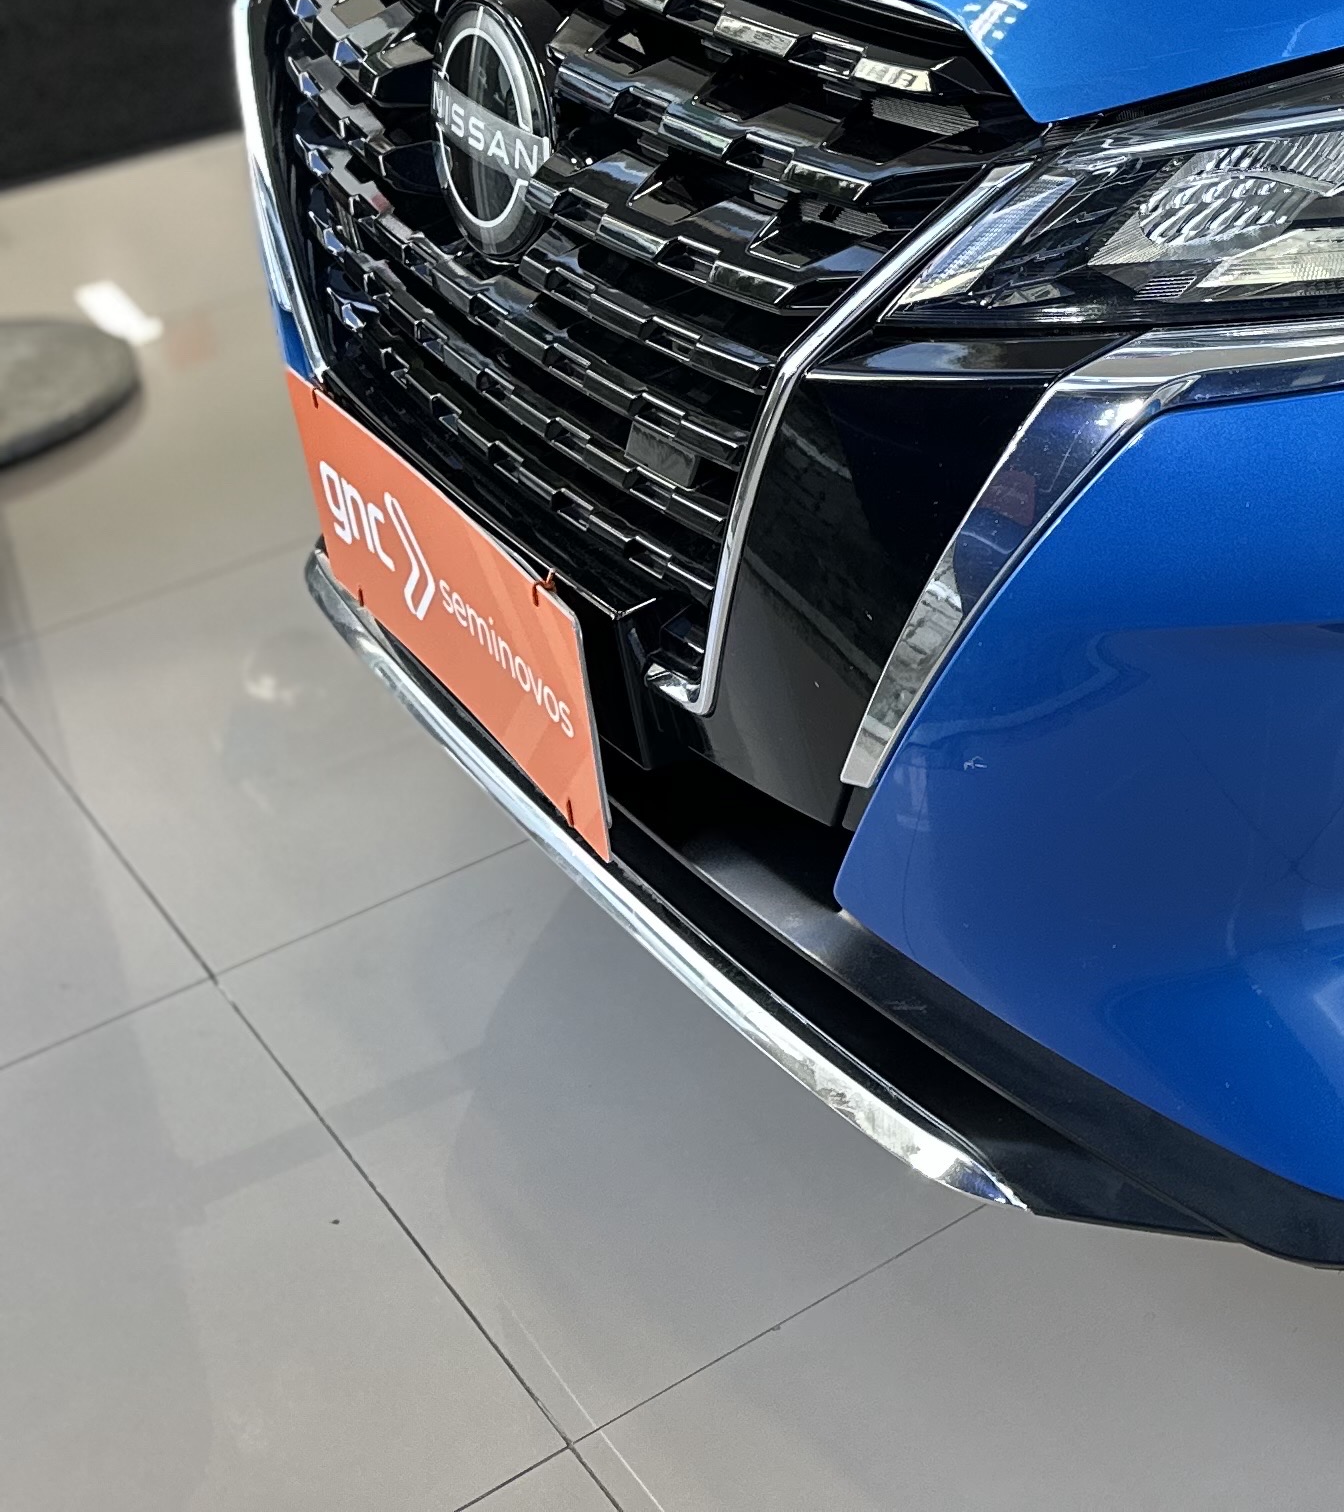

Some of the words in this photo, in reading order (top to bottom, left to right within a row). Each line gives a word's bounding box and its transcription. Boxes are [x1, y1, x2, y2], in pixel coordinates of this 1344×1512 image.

[432, 79, 539, 177] NISSAN
[318, 460, 396, 573] gnc
[438, 577, 576, 739] seminovos
